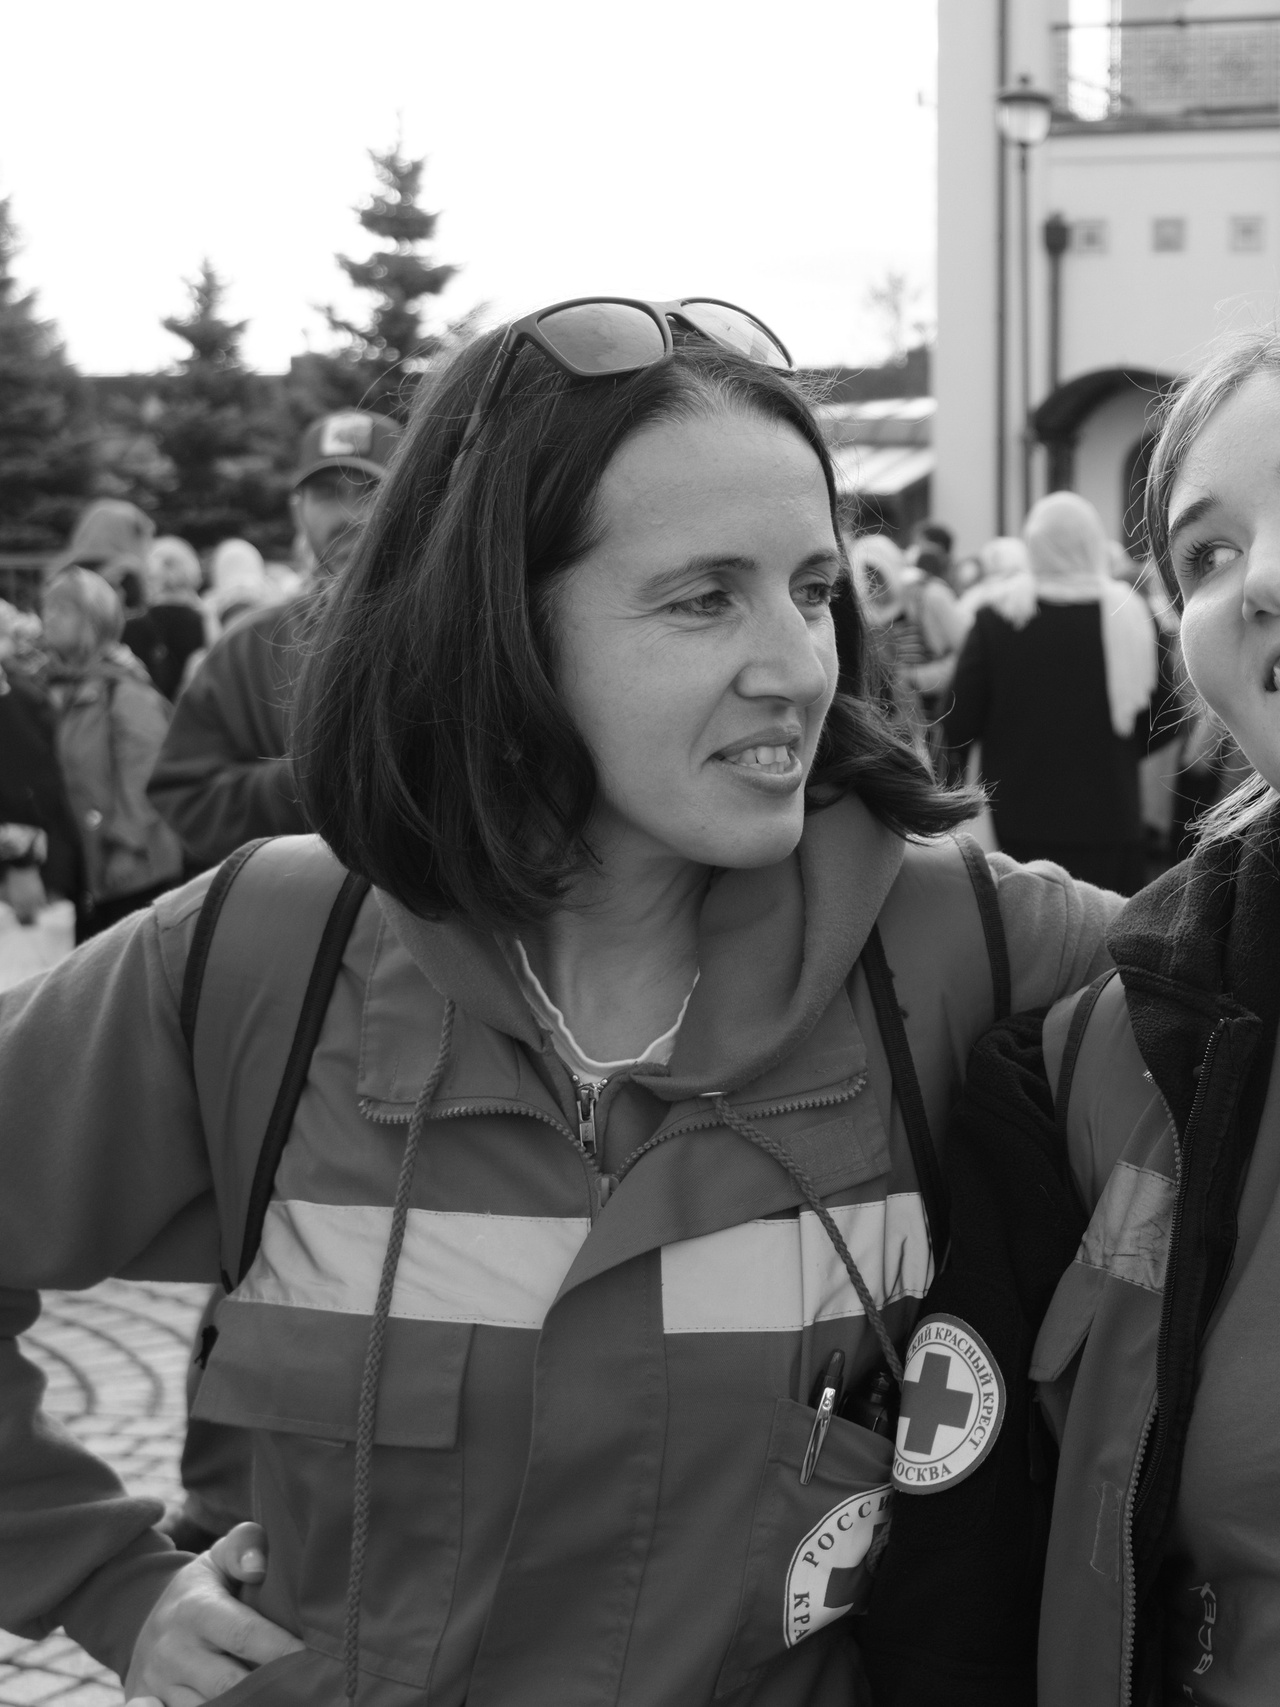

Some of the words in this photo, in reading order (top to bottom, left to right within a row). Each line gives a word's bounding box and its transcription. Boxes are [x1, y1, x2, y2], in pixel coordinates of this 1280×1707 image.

[489, 361, 502, 384] Polaroid
[934, 1326, 995, 1388] КРАСНЫЙ
[968, 1390, 995, 1451] КРЕСТ
[802, 1494, 891, 1568] РОССИ
[794, 1590, 811, 1641] КРА
